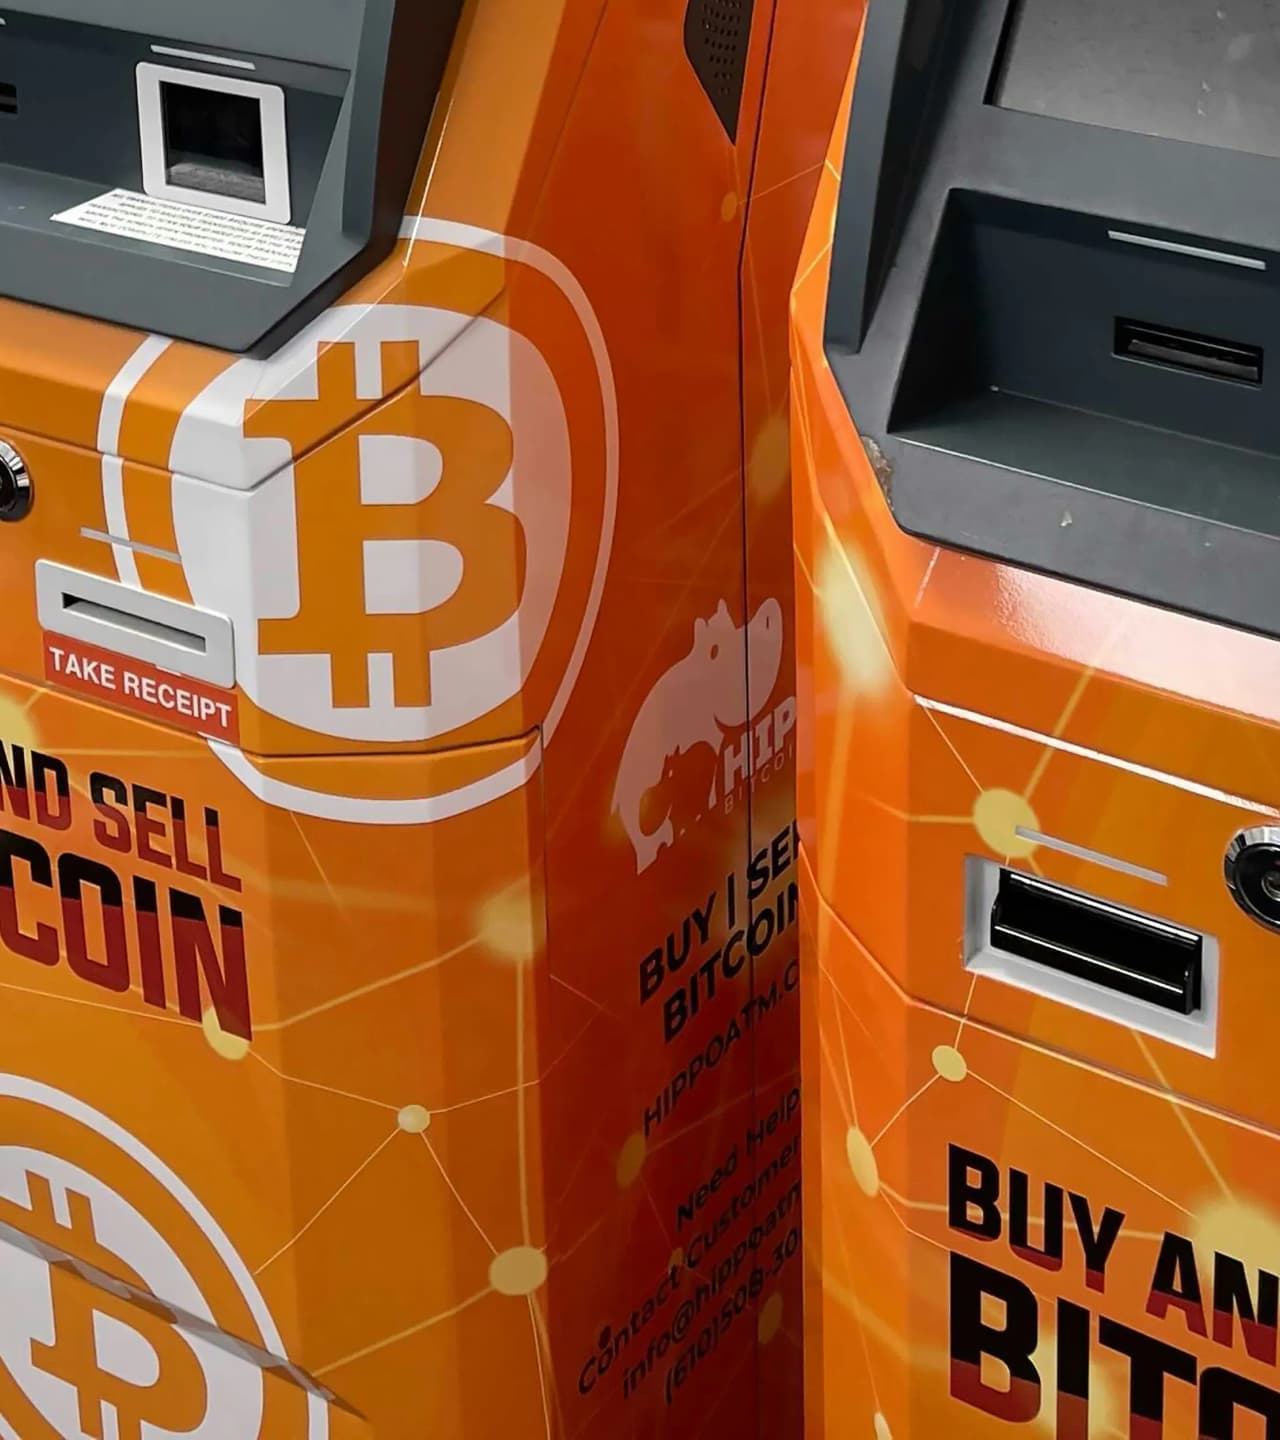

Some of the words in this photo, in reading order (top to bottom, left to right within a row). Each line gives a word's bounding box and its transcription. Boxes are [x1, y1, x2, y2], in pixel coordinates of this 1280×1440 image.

[49, 647, 116, 690] TAKE
[123, 671, 232, 727] RECEIPT
[90, 771, 242, 892] SELL
[640, 891, 716, 1005] BUY
[948, 1142, 1126, 1295] BUY
[578, 1263, 681, 1395] Contact
